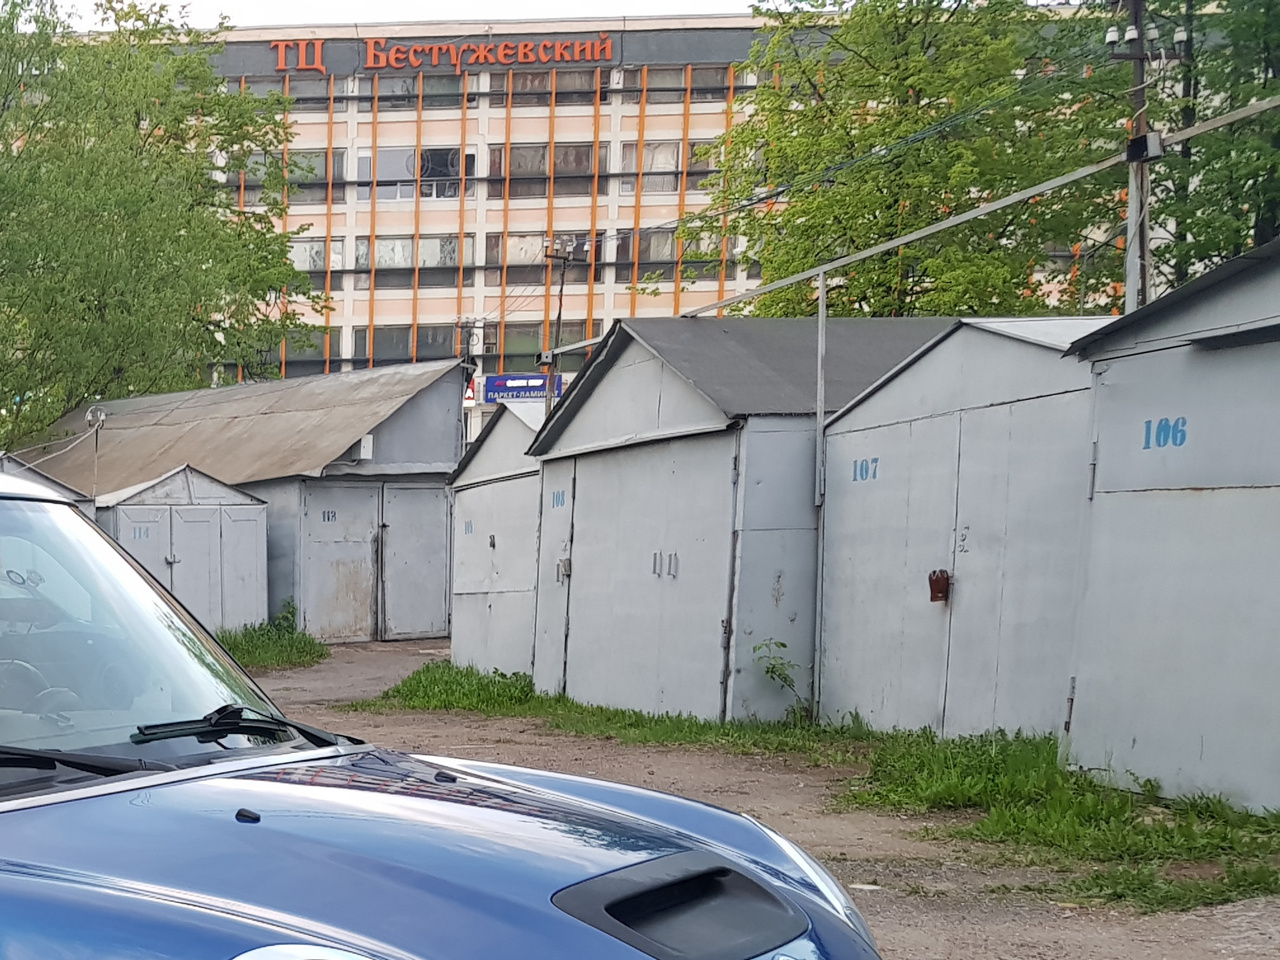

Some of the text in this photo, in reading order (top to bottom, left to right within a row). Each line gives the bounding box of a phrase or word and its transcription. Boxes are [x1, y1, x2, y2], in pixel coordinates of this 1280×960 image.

[270, 31, 613, 75] ТЦ Бестужевский
[1142, 416, 1187, 450] 106
[852, 457, 880, 482] 107
[552, 490, 566, 509] 108
